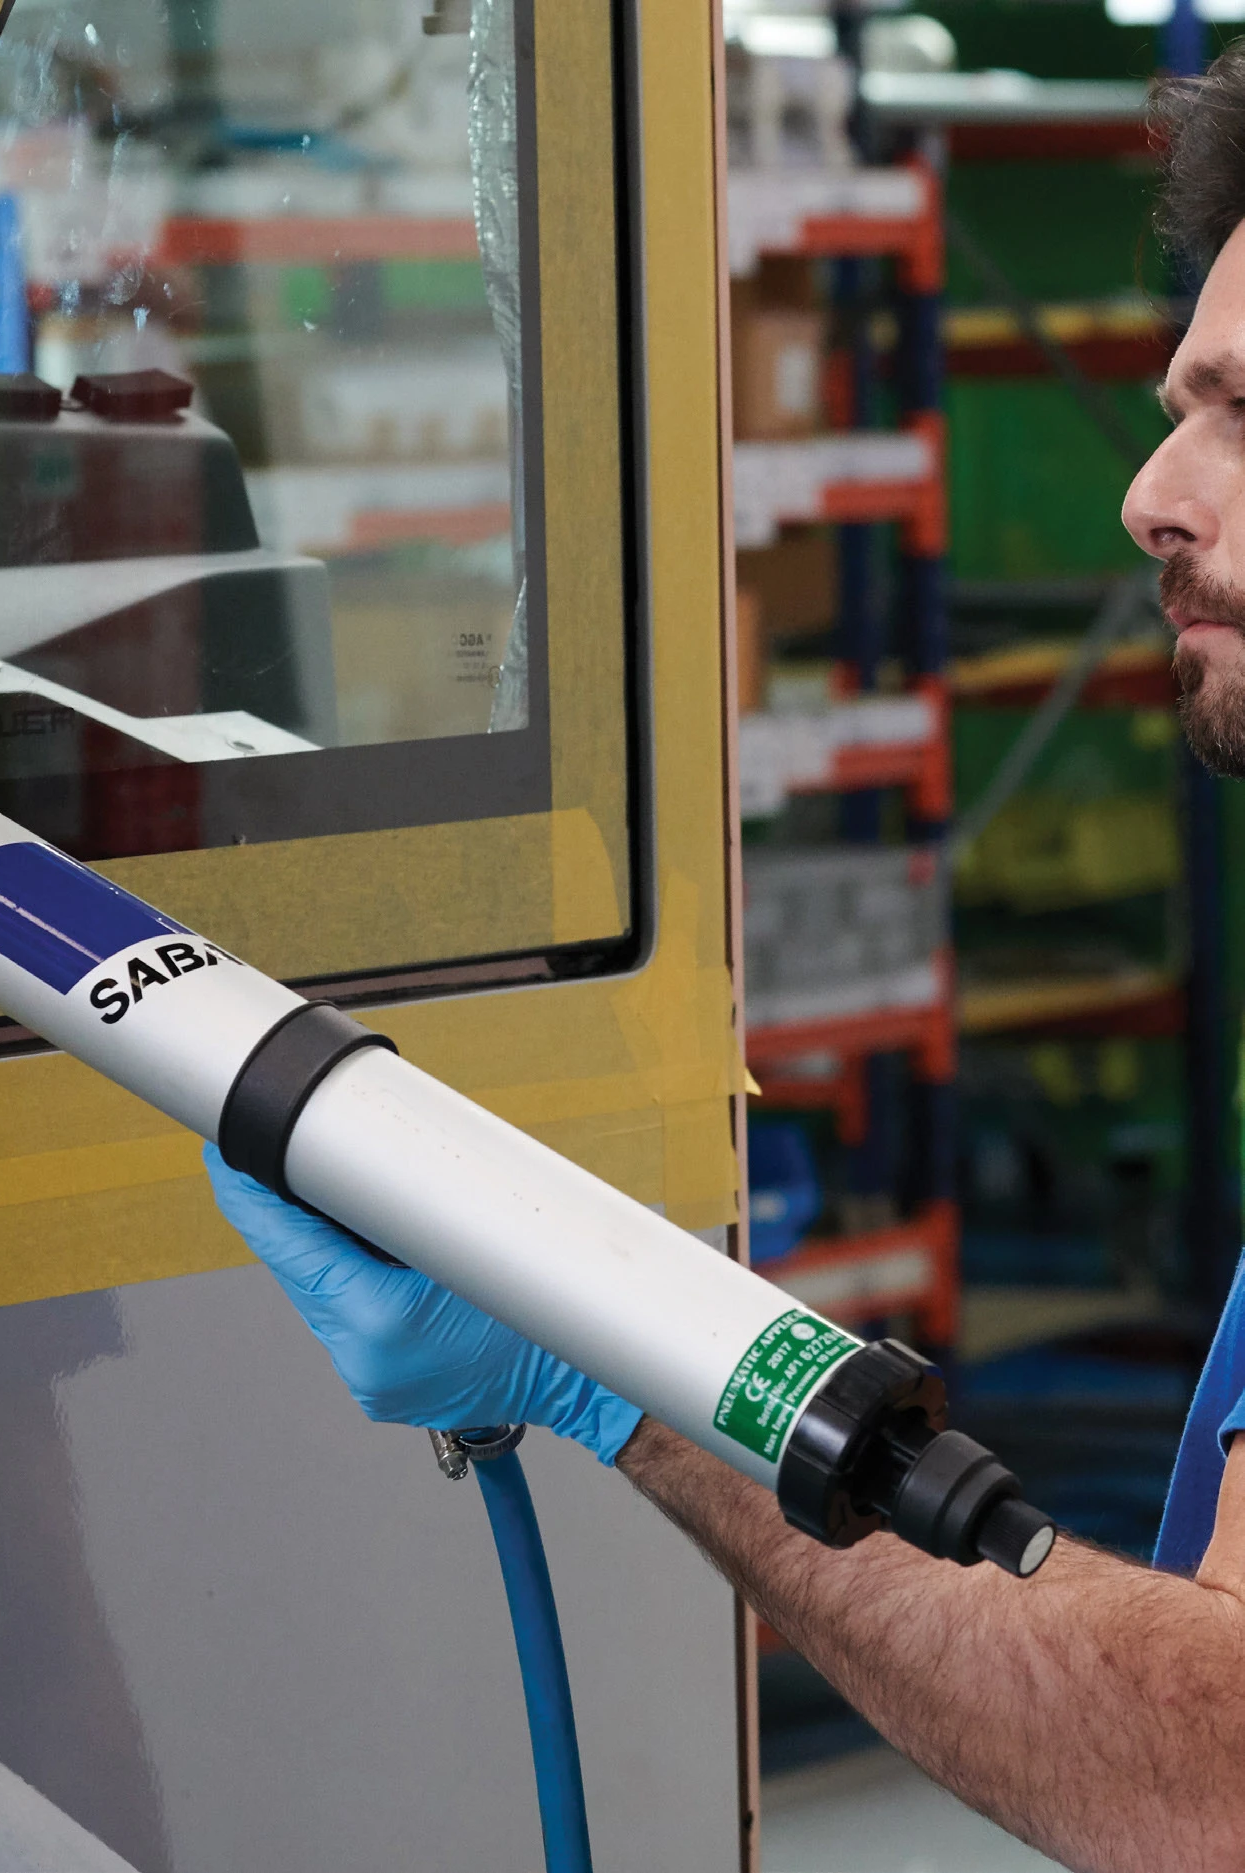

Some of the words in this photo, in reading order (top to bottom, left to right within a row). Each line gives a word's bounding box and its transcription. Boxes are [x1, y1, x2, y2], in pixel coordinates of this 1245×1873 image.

[90, 943, 245, 1024] SABA
[716, 1345, 763, 1426] PNEUMATIC
[766, 1340, 792, 1370] 2017
